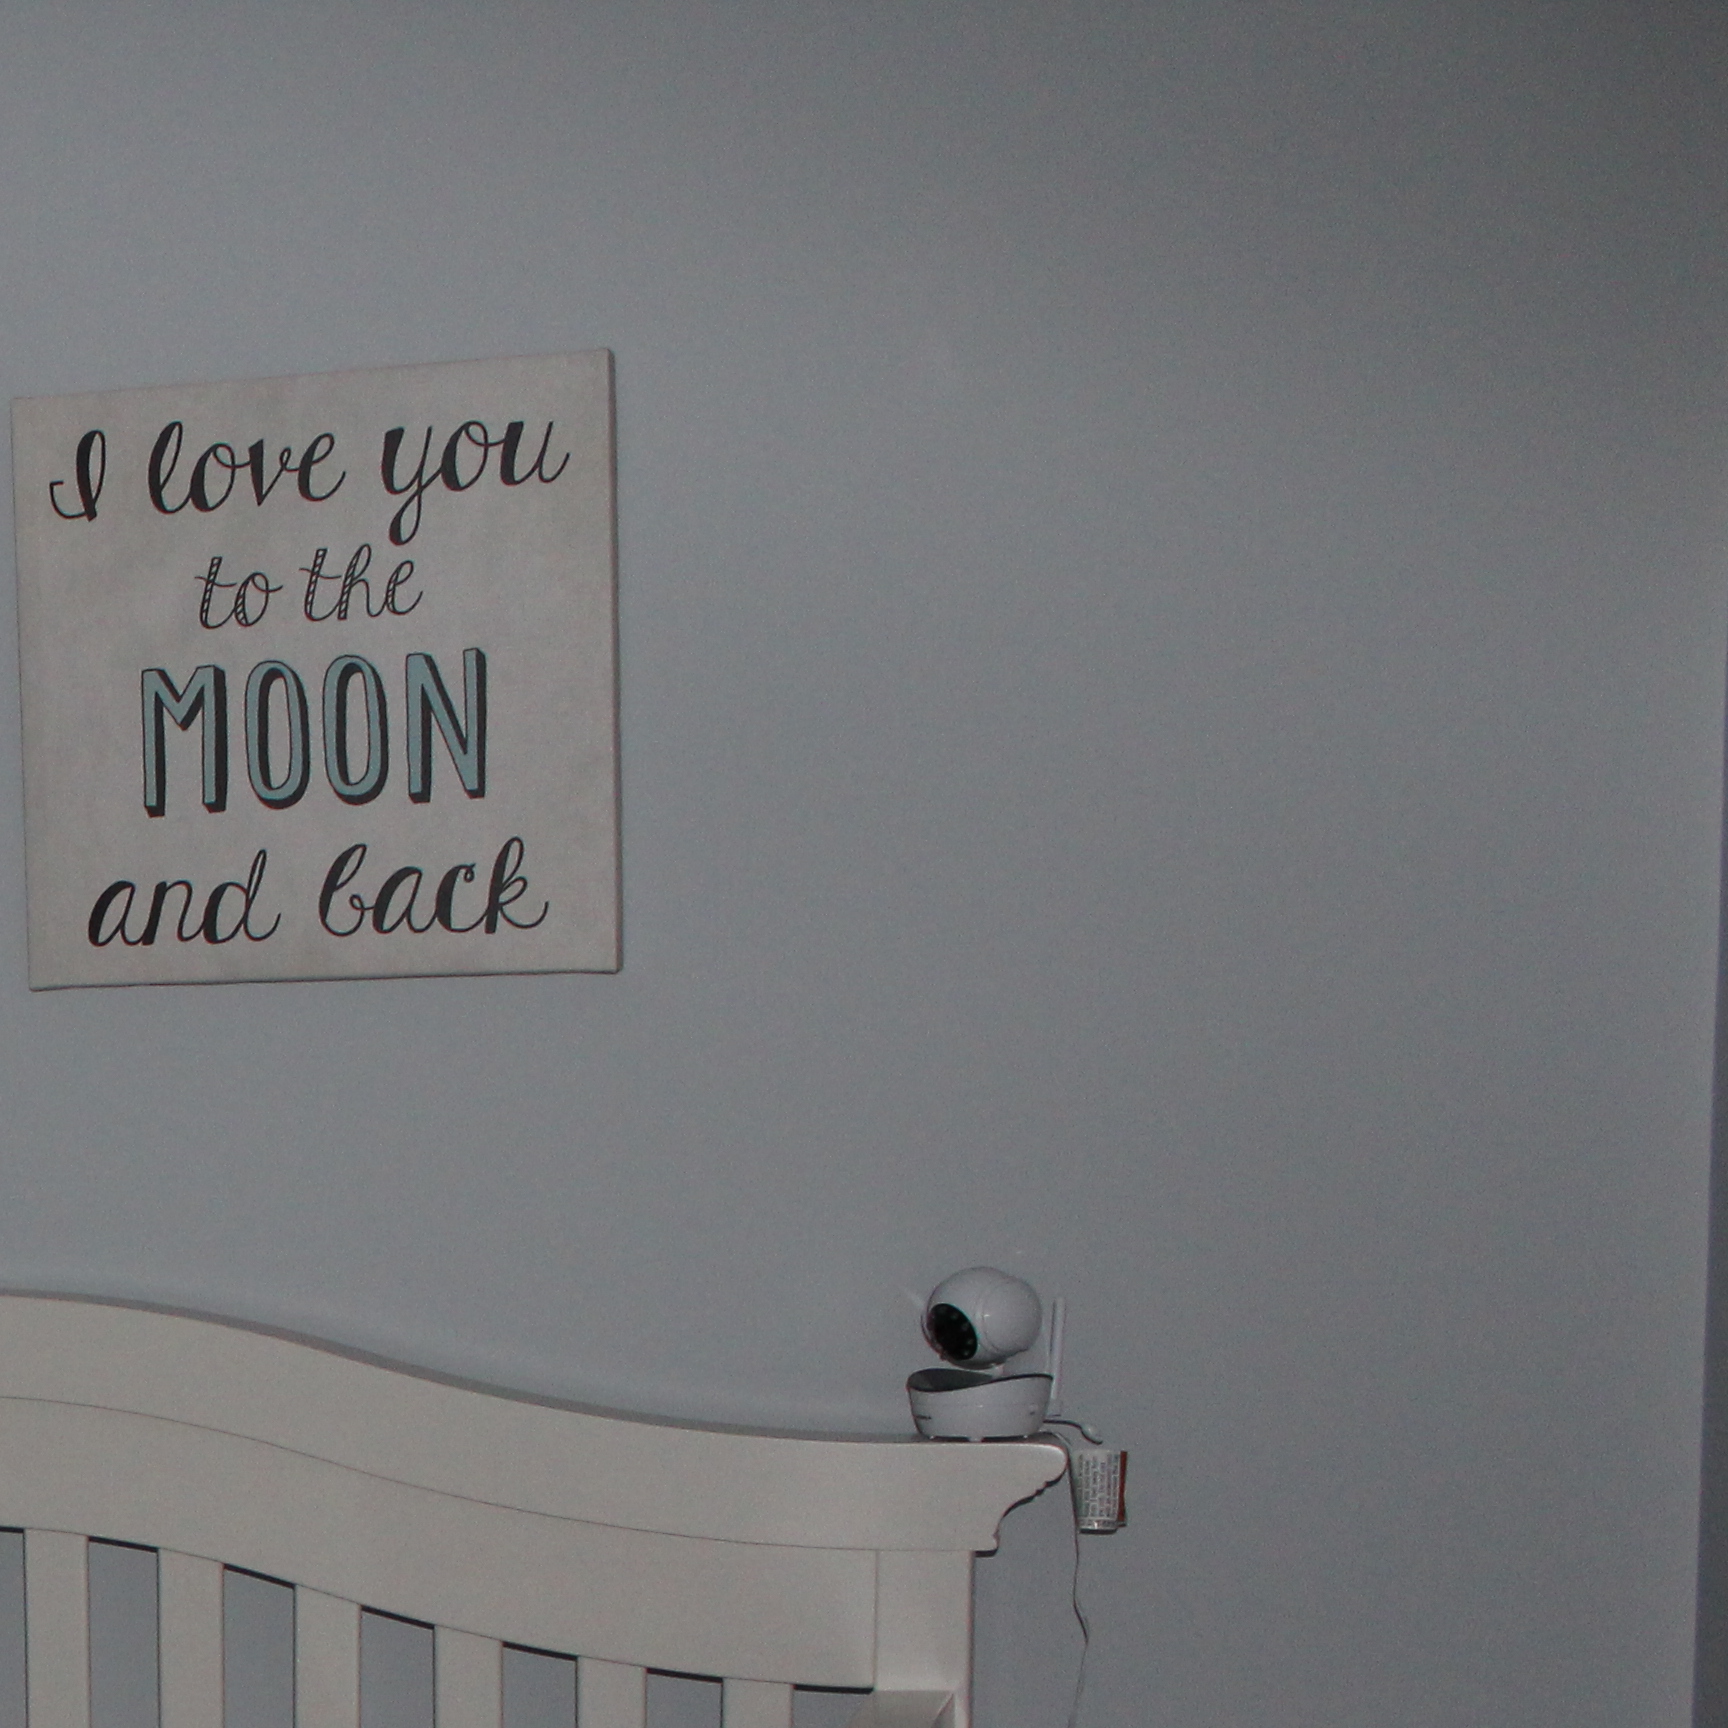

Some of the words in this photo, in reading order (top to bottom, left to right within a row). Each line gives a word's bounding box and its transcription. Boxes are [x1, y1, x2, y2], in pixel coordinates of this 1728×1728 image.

[50, 430, 106, 521] I
[147, 421, 346, 514] love
[381, 421, 570, 545] you
[195, 556, 283, 629] to
[300, 543, 423, 621] the
[141, 647, 487, 817] MOON
[88, 849, 281, 946] and
[319, 837, 549, 936] back
